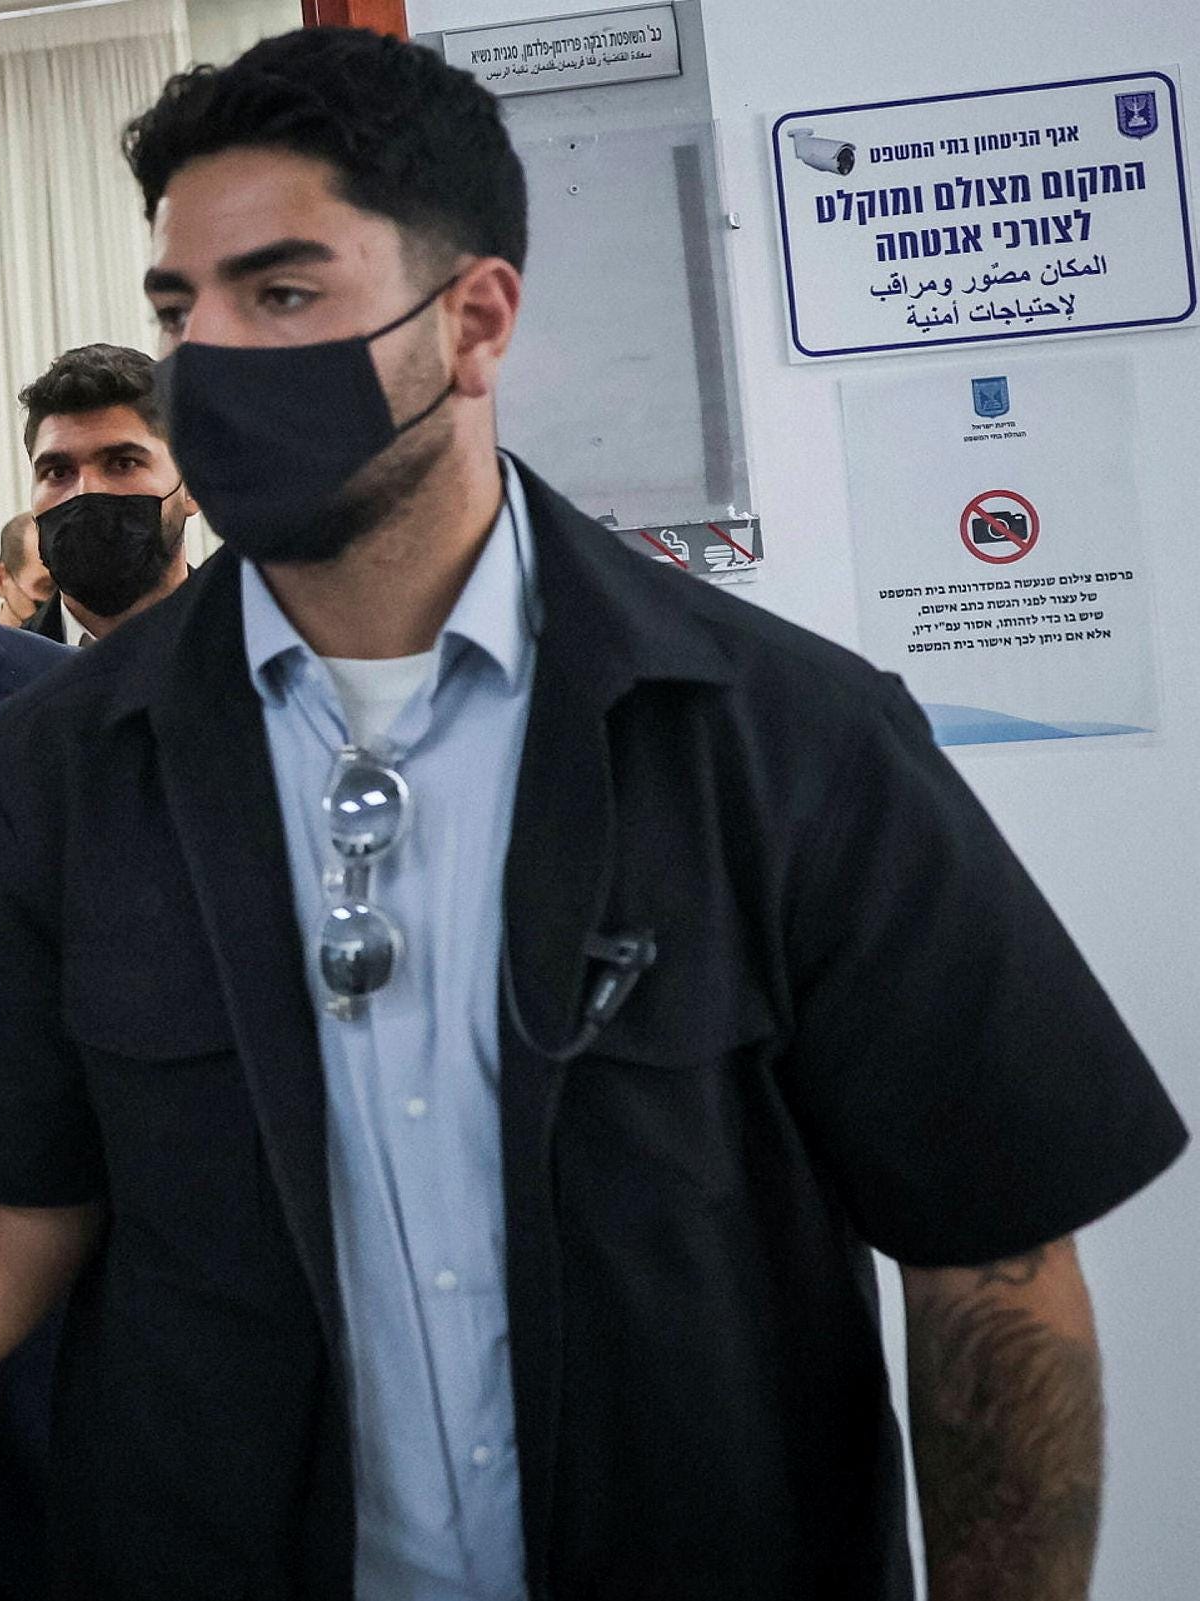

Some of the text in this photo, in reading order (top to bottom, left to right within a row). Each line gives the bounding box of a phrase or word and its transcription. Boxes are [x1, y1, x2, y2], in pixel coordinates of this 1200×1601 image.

[583, 34, 607, 54] רבקה
[609, 29, 647, 47] השופטת
[471, 48, 491, 64] נשיא
[493, 45, 518, 61] סגנית
[869, 125, 1079, 163] אגף הביטחון בתי המשפט
[815, 161, 1146, 226] המקום מצולם ומוקלט
[876, 209, 1091, 262] לצורכי אבטחה
[1040, 254, 1108, 286] المكان
[870, 272, 953, 302] ومراقب
[906, 293, 1076, 333] لإحتياجات أمنية
[879, 571, 1133, 599] פרסום צילום שנעשה במסדרונות בית המשפט
[918, 592, 1097, 616] של עצור לפני הגשת כתב אישום,
[963, 619, 992, 630] אסור
[996, 614, 1038, 629] לזהותו,
[1041, 614, 1061, 623] כדי
[1064, 613, 1076, 622] בו
[1079, 611, 1103, 621] שיש
[912, 624, 932, 636] דין,
[907, 628, 1111, 653] אלא אם ניתן לכך אישור בית המשפט
